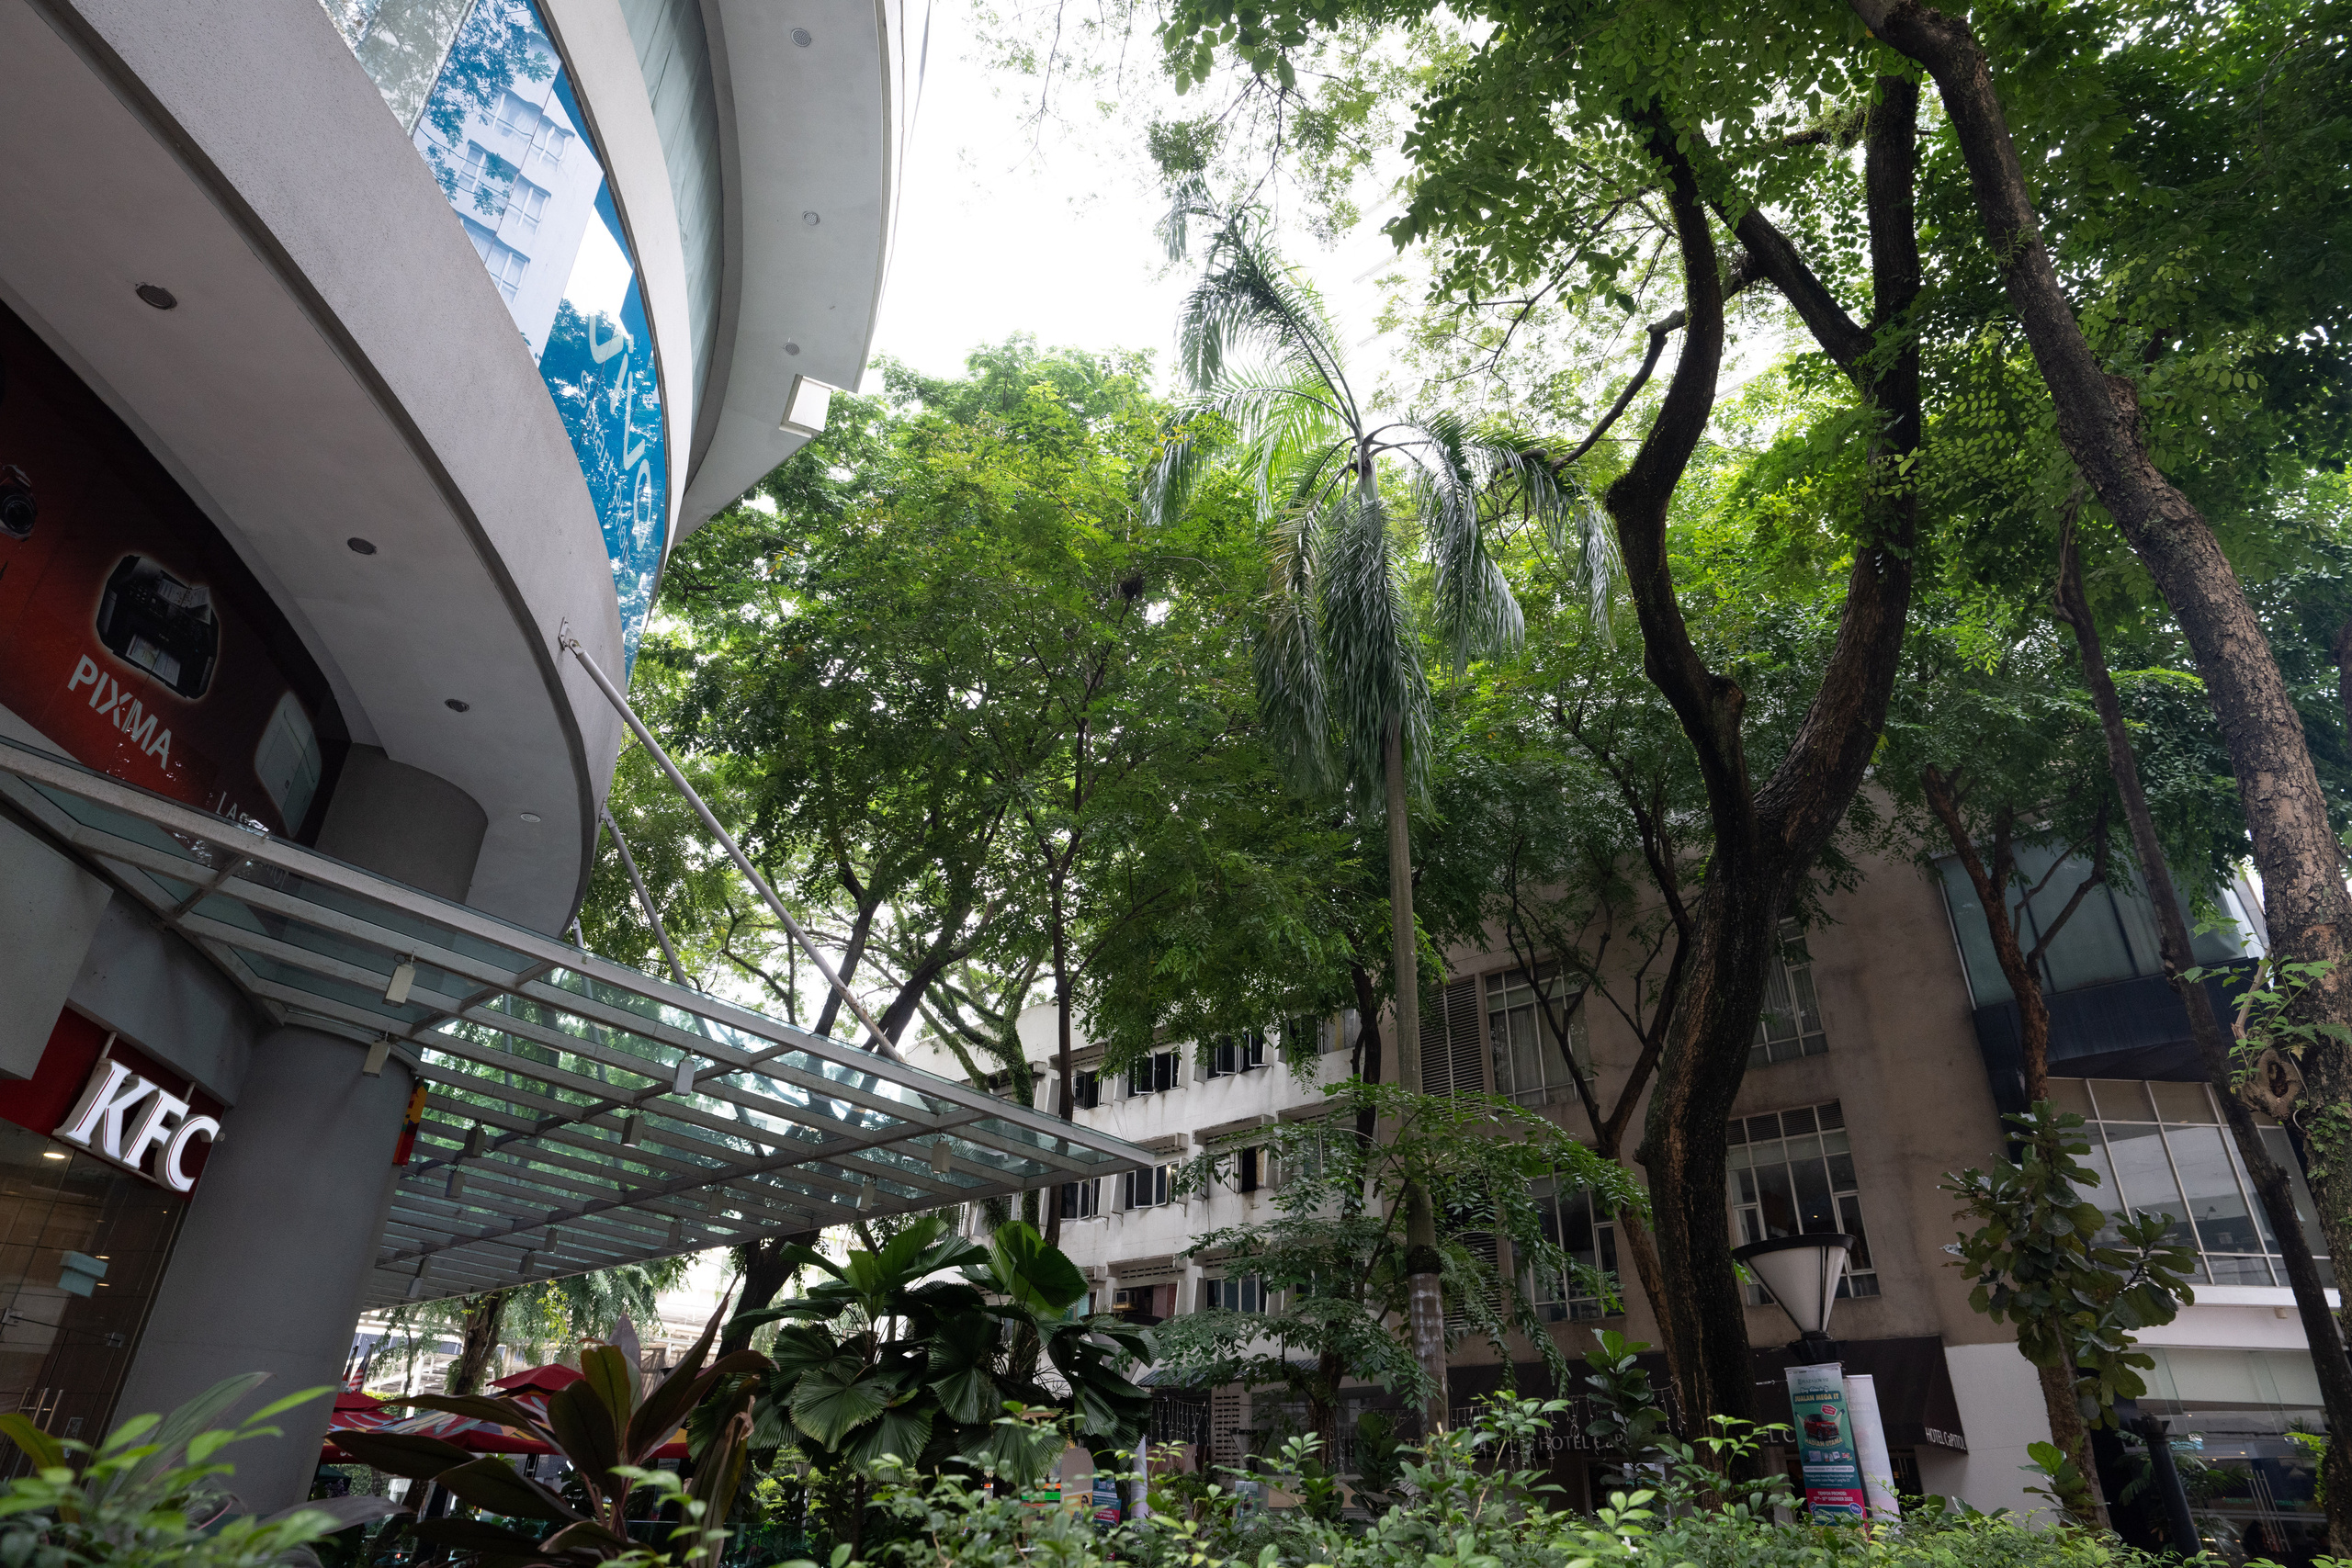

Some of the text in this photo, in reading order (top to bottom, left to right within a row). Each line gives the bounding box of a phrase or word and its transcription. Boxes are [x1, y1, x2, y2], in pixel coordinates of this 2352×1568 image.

[589, 310, 652, 552] vivo
[67, 653, 172, 771] PIXMA
[59, 1058, 220, 1193] KFC
[1794, 1394, 1815, 1403] JUALAN
[1538, 1435, 1590, 1451] HOTEL
[1825, 1437, 1843, 1447] UTAMA
[1925, 1427, 1946, 1445] HOTEL
